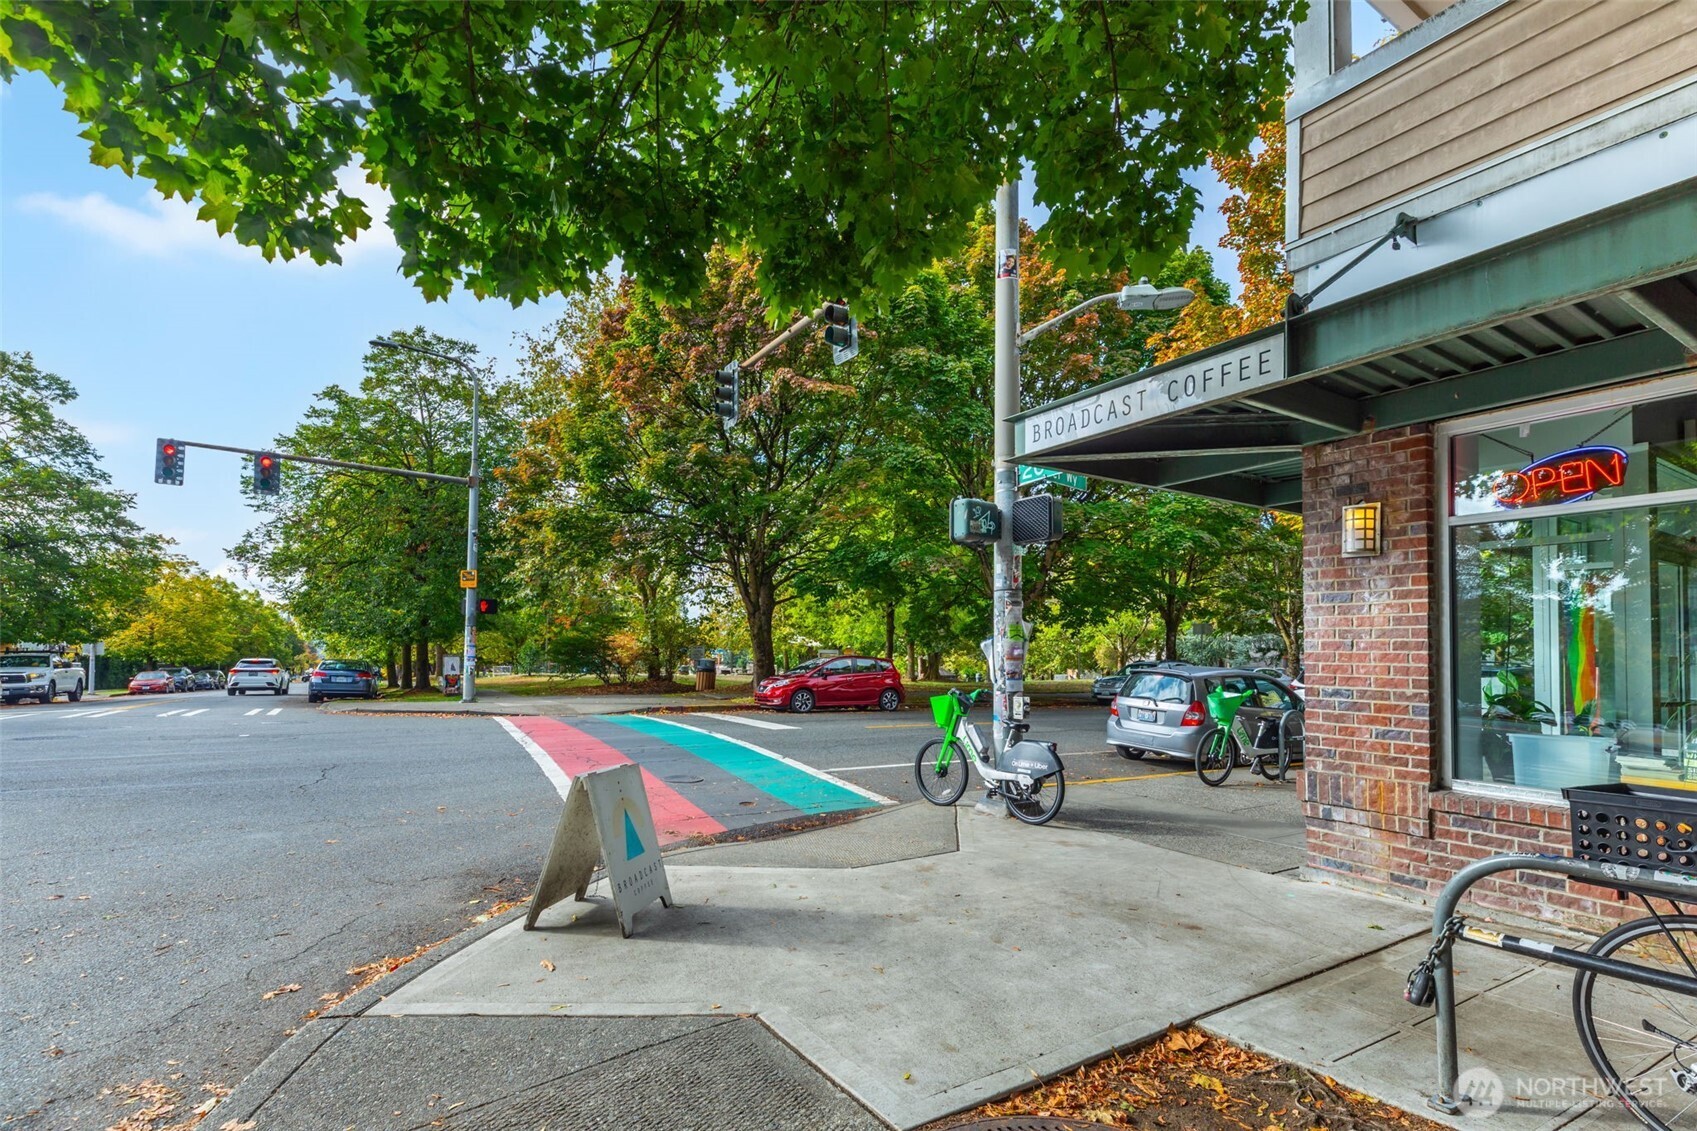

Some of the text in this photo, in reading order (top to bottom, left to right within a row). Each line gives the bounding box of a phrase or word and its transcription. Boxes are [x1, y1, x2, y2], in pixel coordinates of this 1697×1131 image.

[1033, 349, 1272, 443] BROADCAST COFFEE
[1493, 453, 1620, 502] OPEN
[1034, 761, 1049, 770] Uber
[617, 859, 662, 894] BROADCAST
